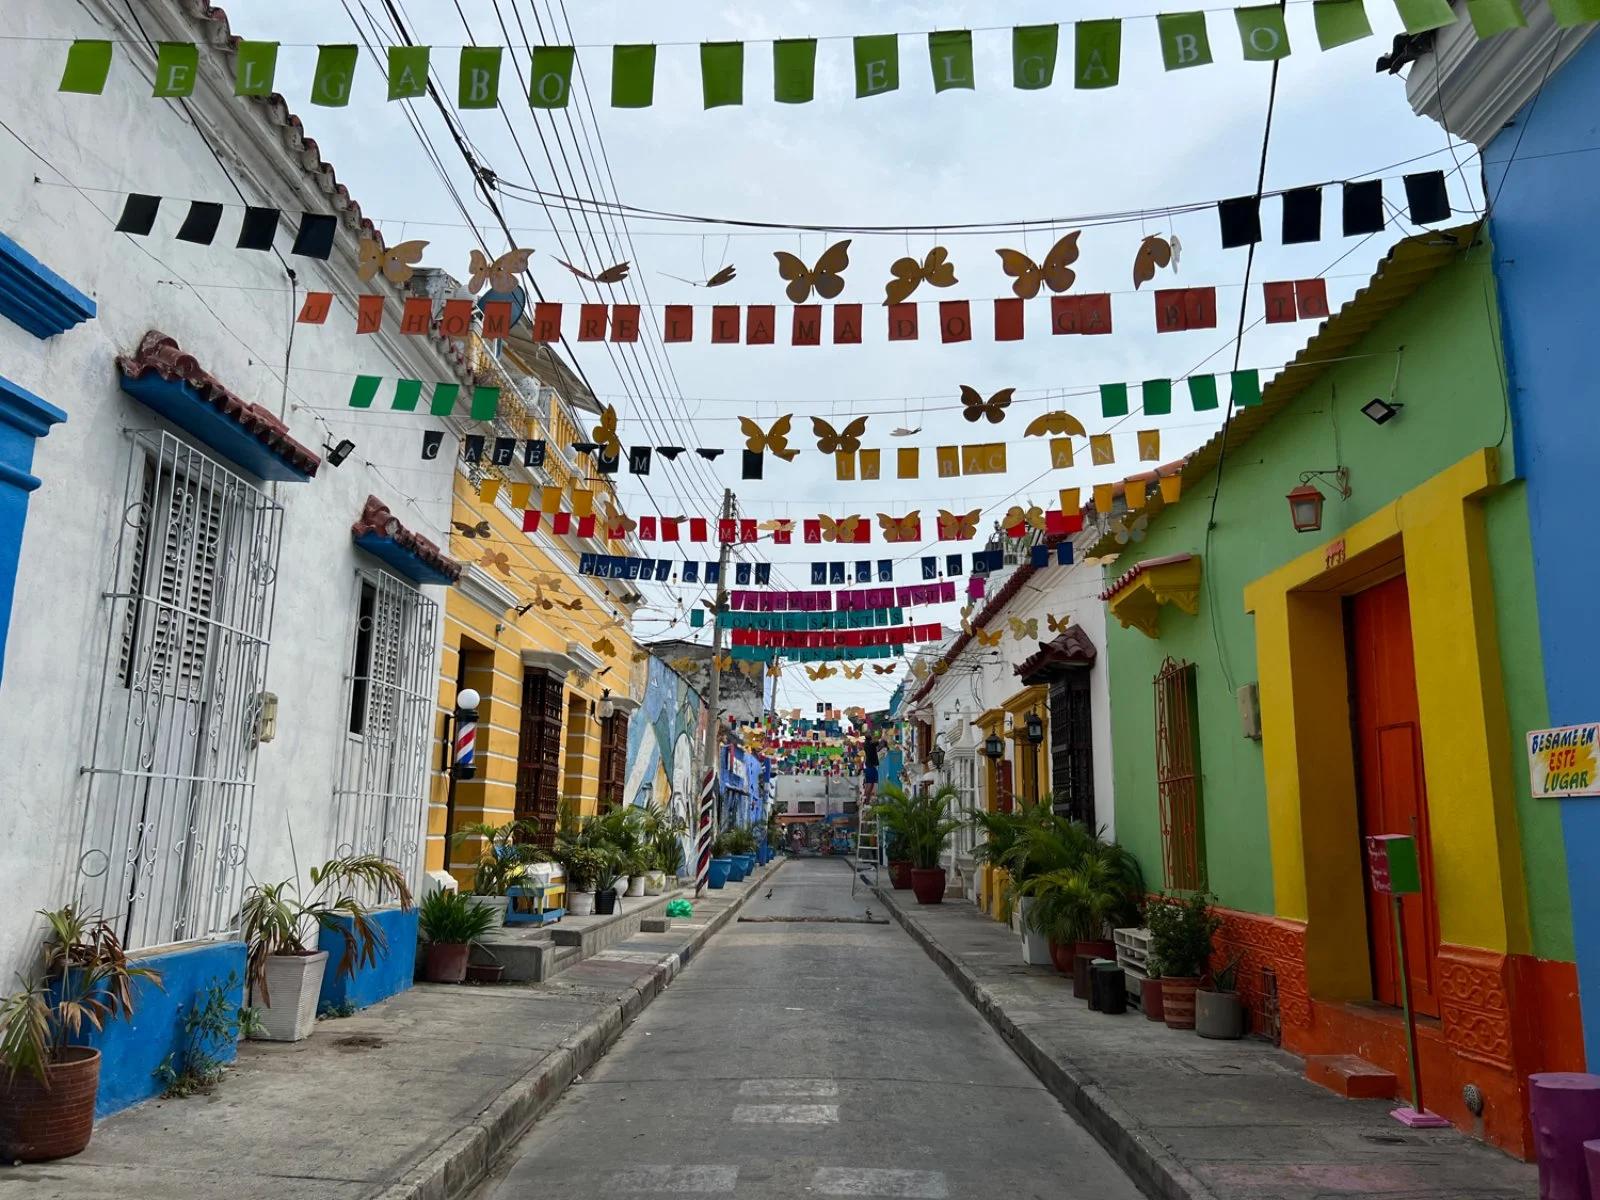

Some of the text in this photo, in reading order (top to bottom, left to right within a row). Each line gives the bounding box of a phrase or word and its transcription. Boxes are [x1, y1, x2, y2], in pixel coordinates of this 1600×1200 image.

[1581, 727, 1595, 746] EN
[1549, 750, 1576, 772] ESTE
[1543, 771, 1589, 793] LUGAR
